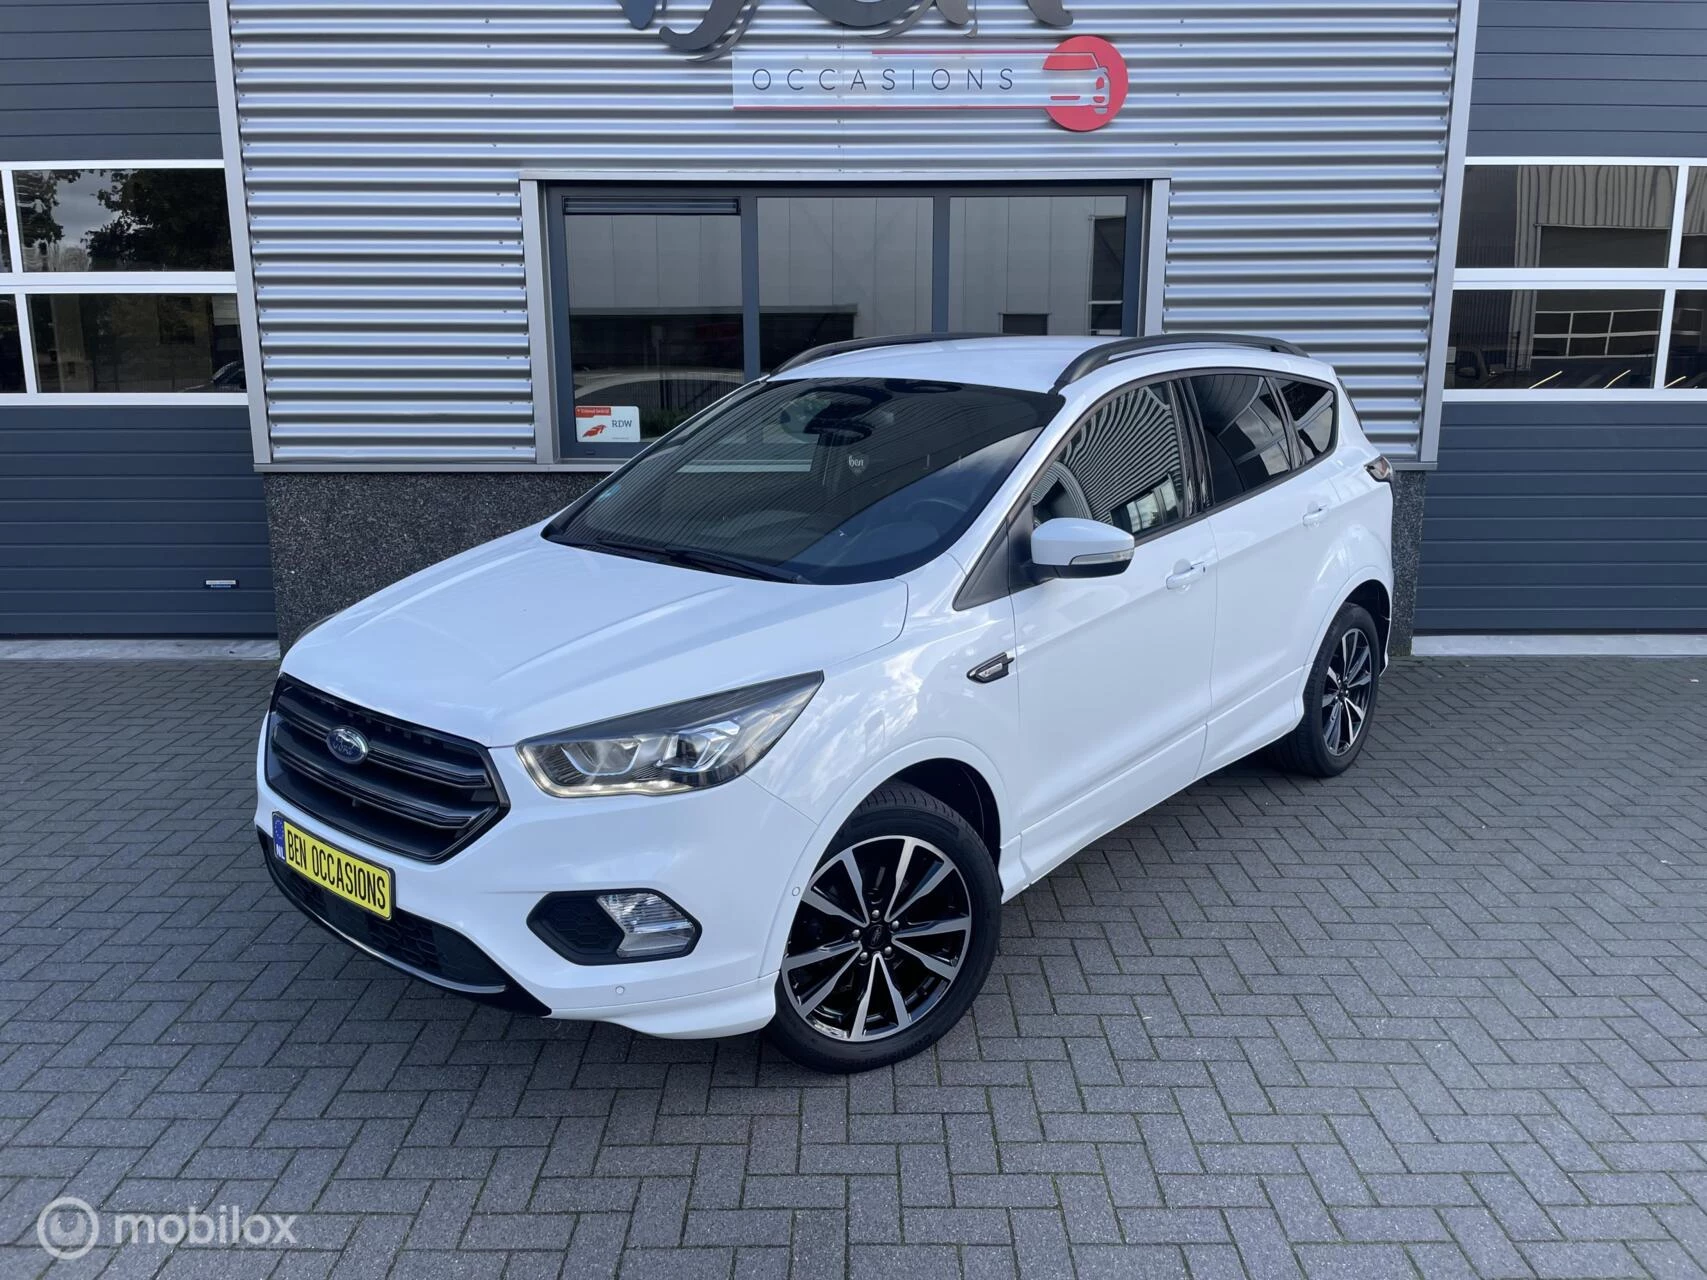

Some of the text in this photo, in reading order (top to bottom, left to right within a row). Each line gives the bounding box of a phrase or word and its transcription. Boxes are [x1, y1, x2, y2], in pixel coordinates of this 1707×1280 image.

[751, 68, 1013, 91] OCCASIONS
[611, 420, 632, 428] RDW
[287, 829, 386, 910] BEN OCCASIONS
